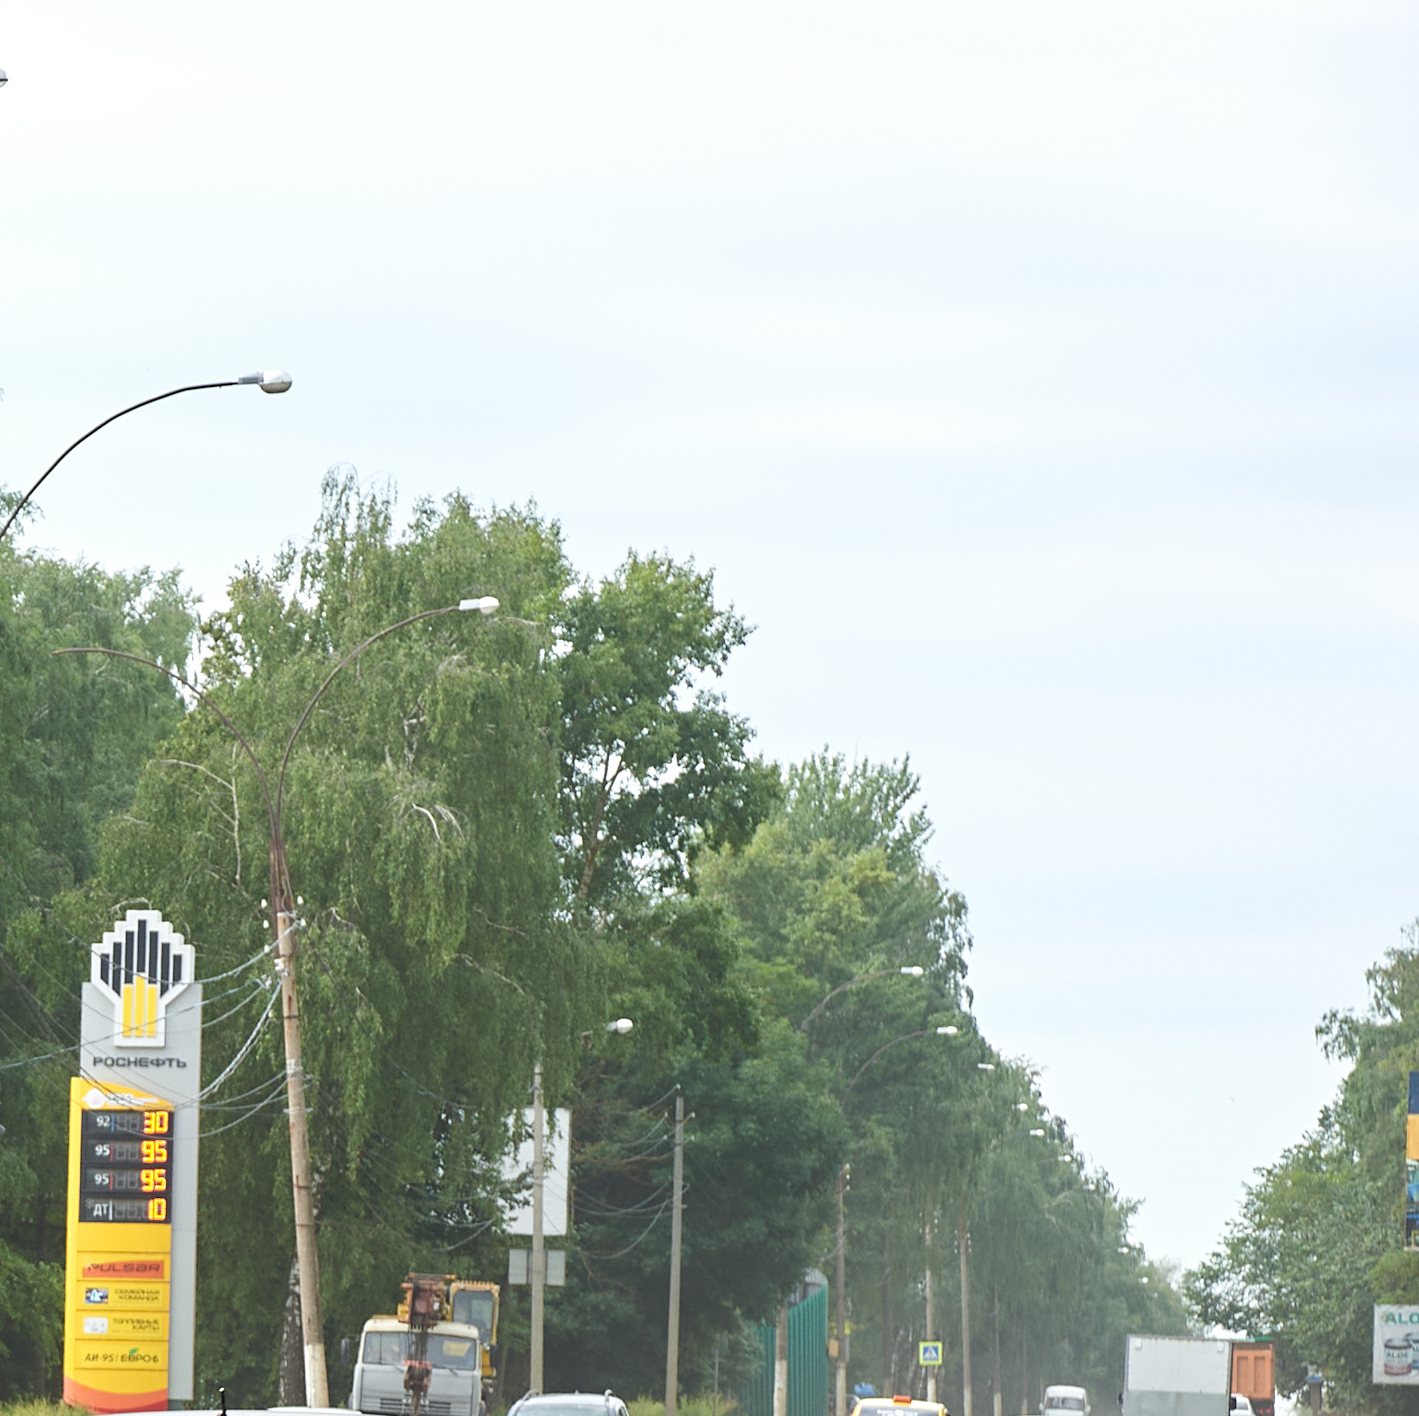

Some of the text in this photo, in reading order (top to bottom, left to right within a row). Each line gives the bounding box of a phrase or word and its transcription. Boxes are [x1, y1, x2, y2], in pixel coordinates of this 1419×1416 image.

[93, 1056, 187, 1068] РОСНЕФТЬ
[96, 1117, 110, 1127] 92
[95, 1140, 167, 1163] 95 95
[94, 1169, 167, 1192] 95 95
[93, 1205, 109, 1217] ДТ
